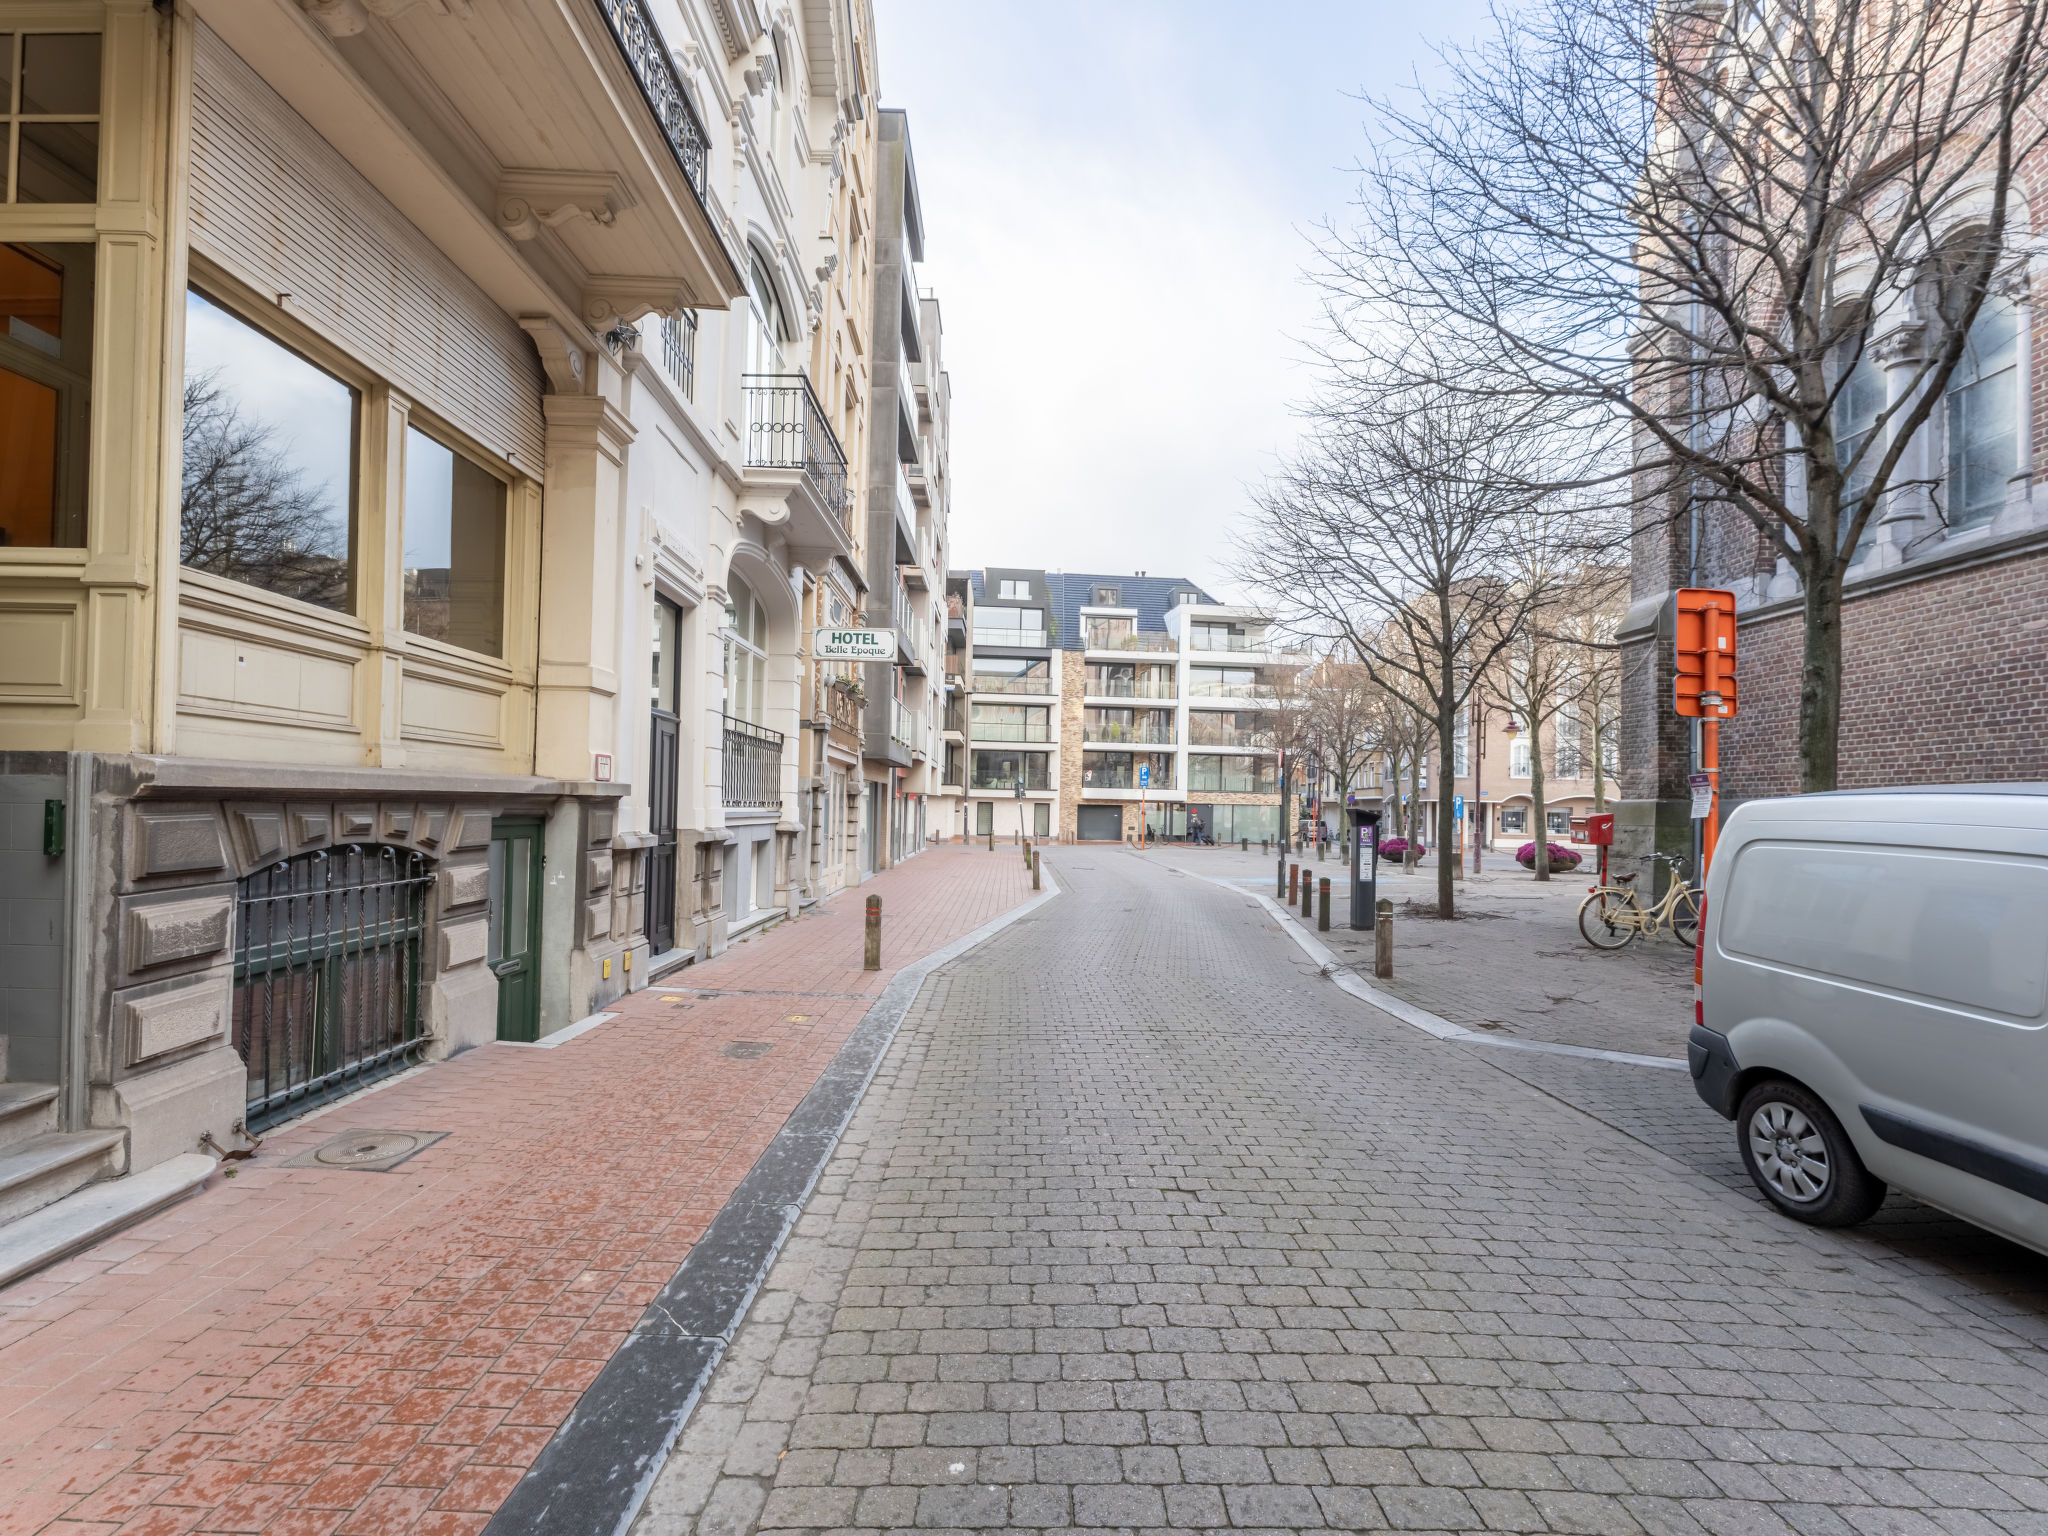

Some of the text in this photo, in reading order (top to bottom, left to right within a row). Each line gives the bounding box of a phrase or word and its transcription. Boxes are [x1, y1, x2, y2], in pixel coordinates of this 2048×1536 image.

[831, 632, 879, 645] HOTEL
[825, 645, 886, 656] Belle Epoque
[1142, 767, 1148, 775] P
[1456, 797, 1462, 810] P
[1361, 827, 1369, 838] P
